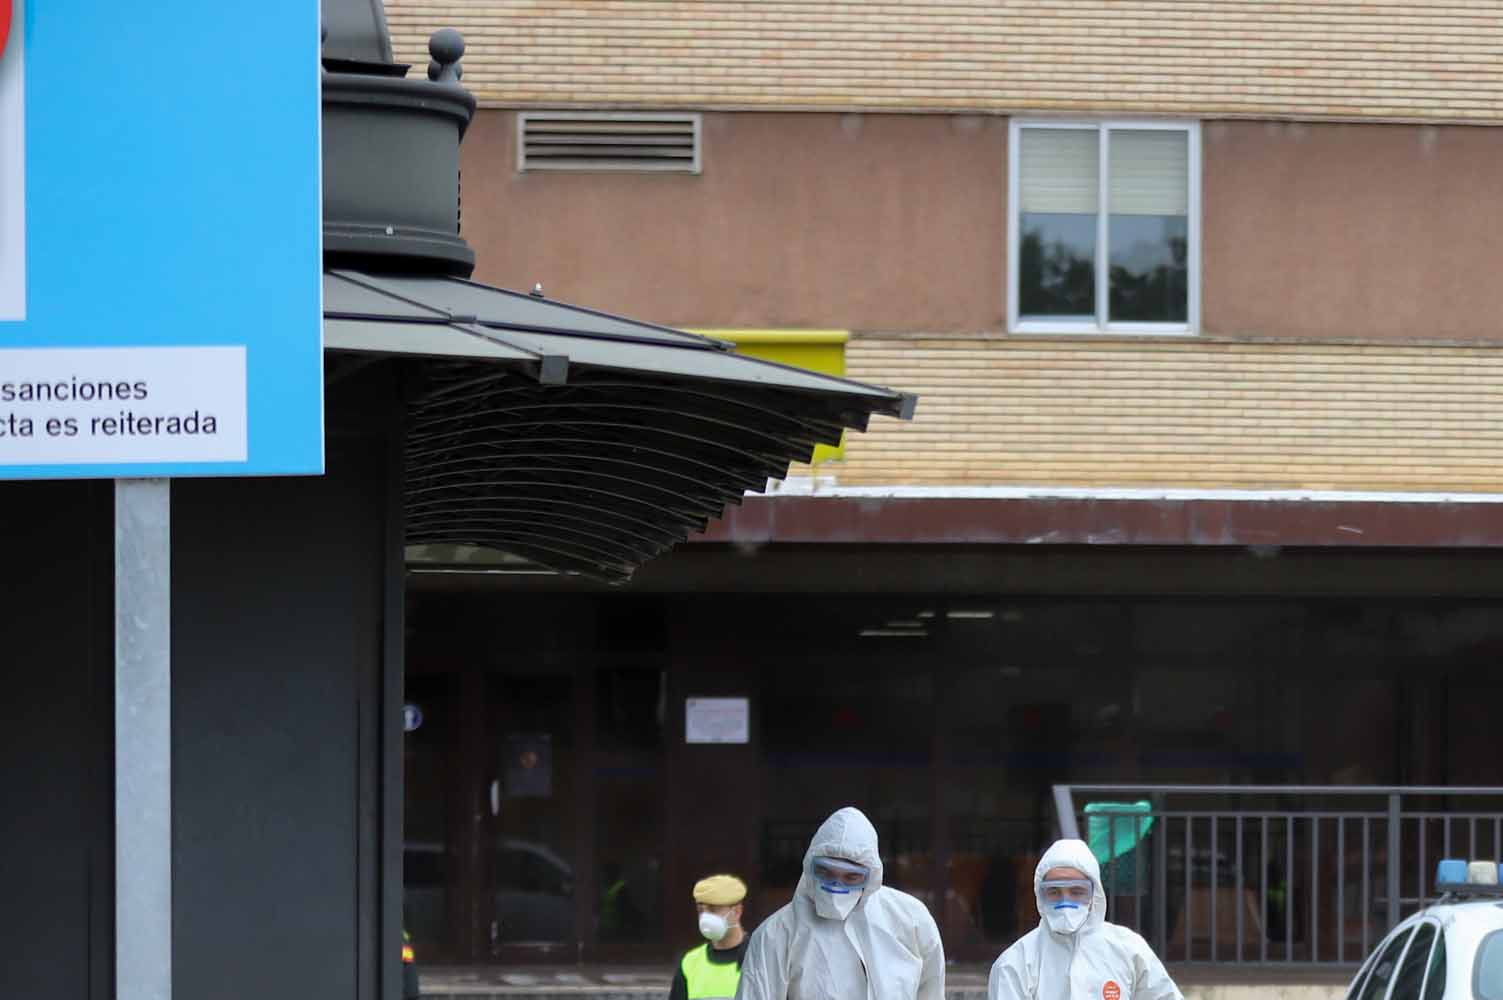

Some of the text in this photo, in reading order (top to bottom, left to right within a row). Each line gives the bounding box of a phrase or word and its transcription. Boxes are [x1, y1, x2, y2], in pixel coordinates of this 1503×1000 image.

[1, 376, 148, 402] sanciones
[46, 416, 79, 437] es
[91, 410, 217, 436] reiterada
